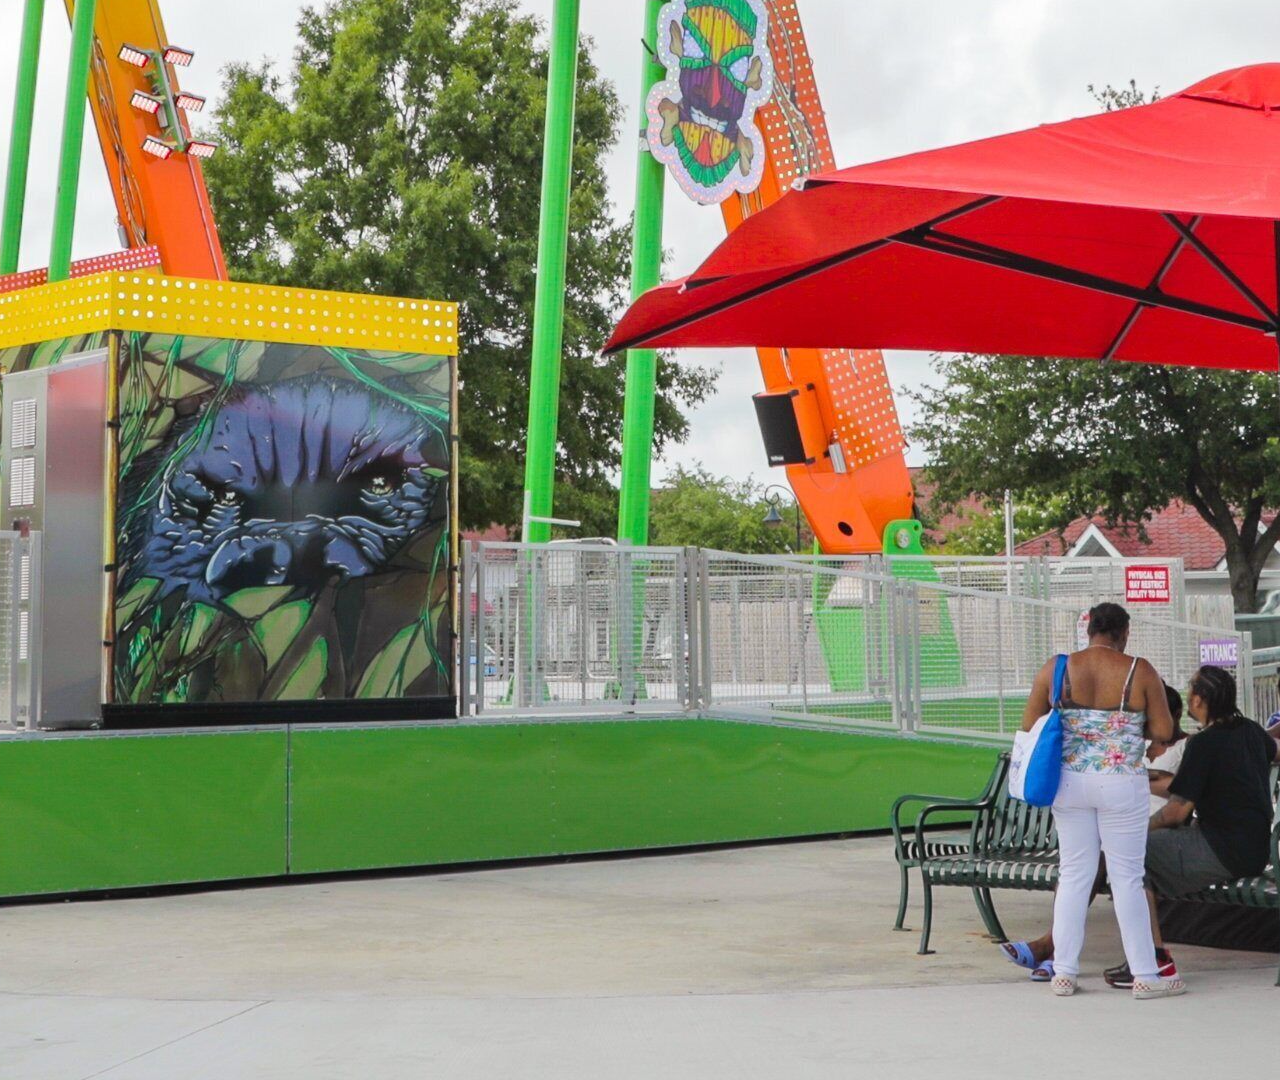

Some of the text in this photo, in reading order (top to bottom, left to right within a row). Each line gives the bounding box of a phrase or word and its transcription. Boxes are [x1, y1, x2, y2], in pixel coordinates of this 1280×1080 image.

[1128, 571, 1166, 579] PHYSICAL SIZE
[1128, 581, 1166, 589] MAY RESTRICT
[1127, 590, 1147, 598] ABILITY
[1148, 590, 1155, 598] TO
[1200, 643, 1237, 662] ENTRANCE
